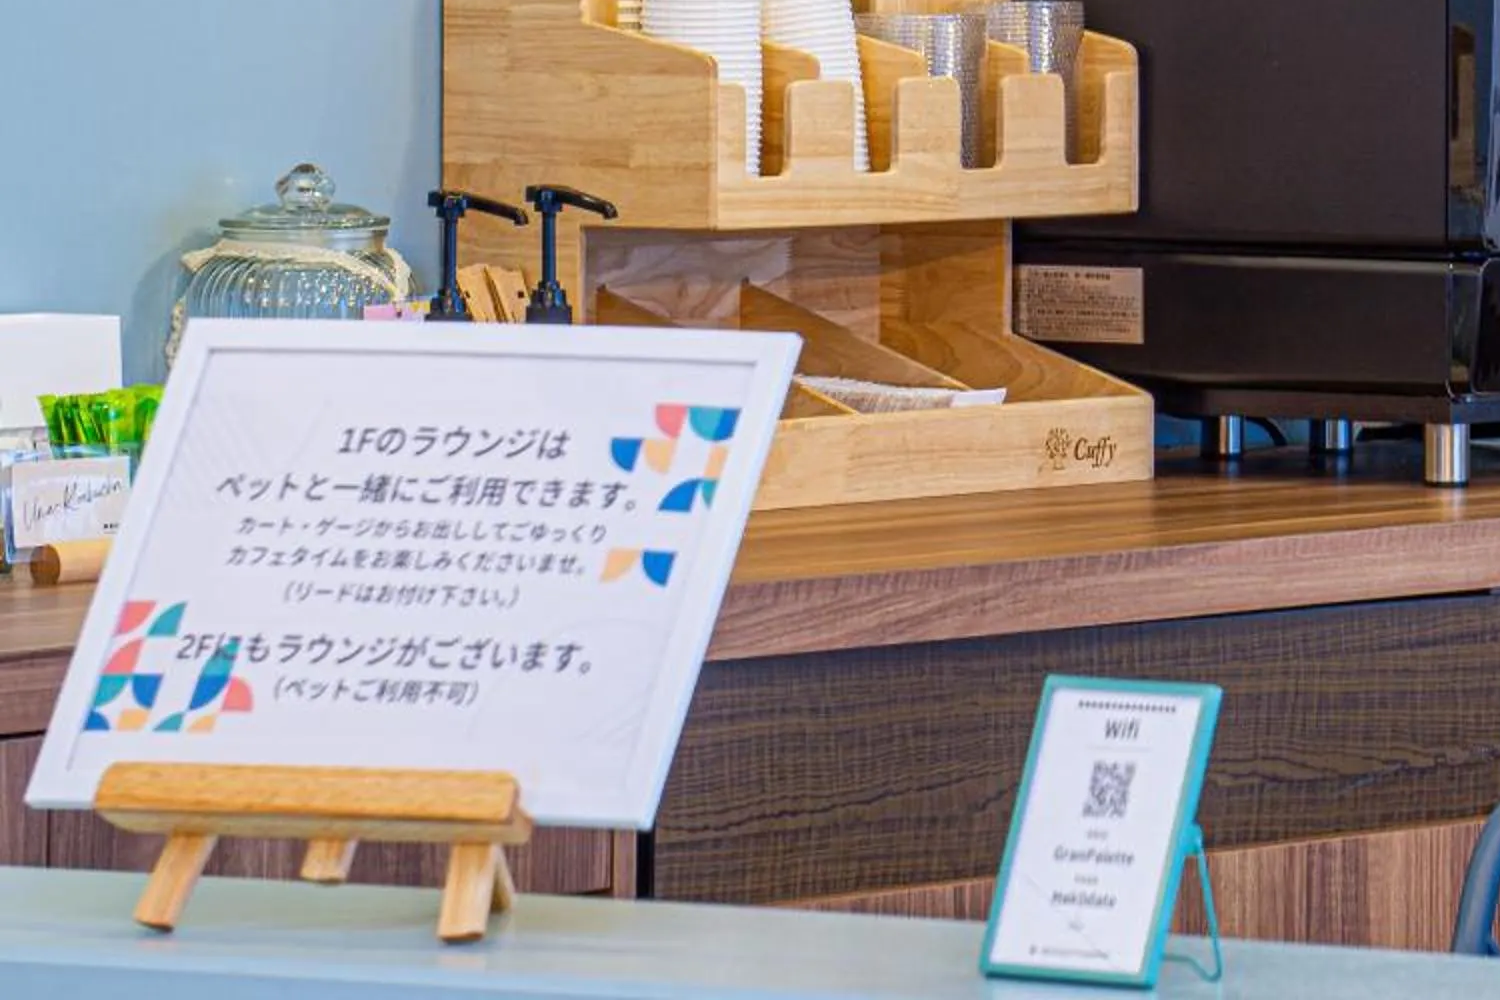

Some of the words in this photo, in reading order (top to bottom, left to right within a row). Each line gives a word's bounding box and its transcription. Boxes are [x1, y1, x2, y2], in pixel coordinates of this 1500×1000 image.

[337, 425, 571, 460] 1Fのラウンジは
[1104, 718, 1141, 741] Wifi
